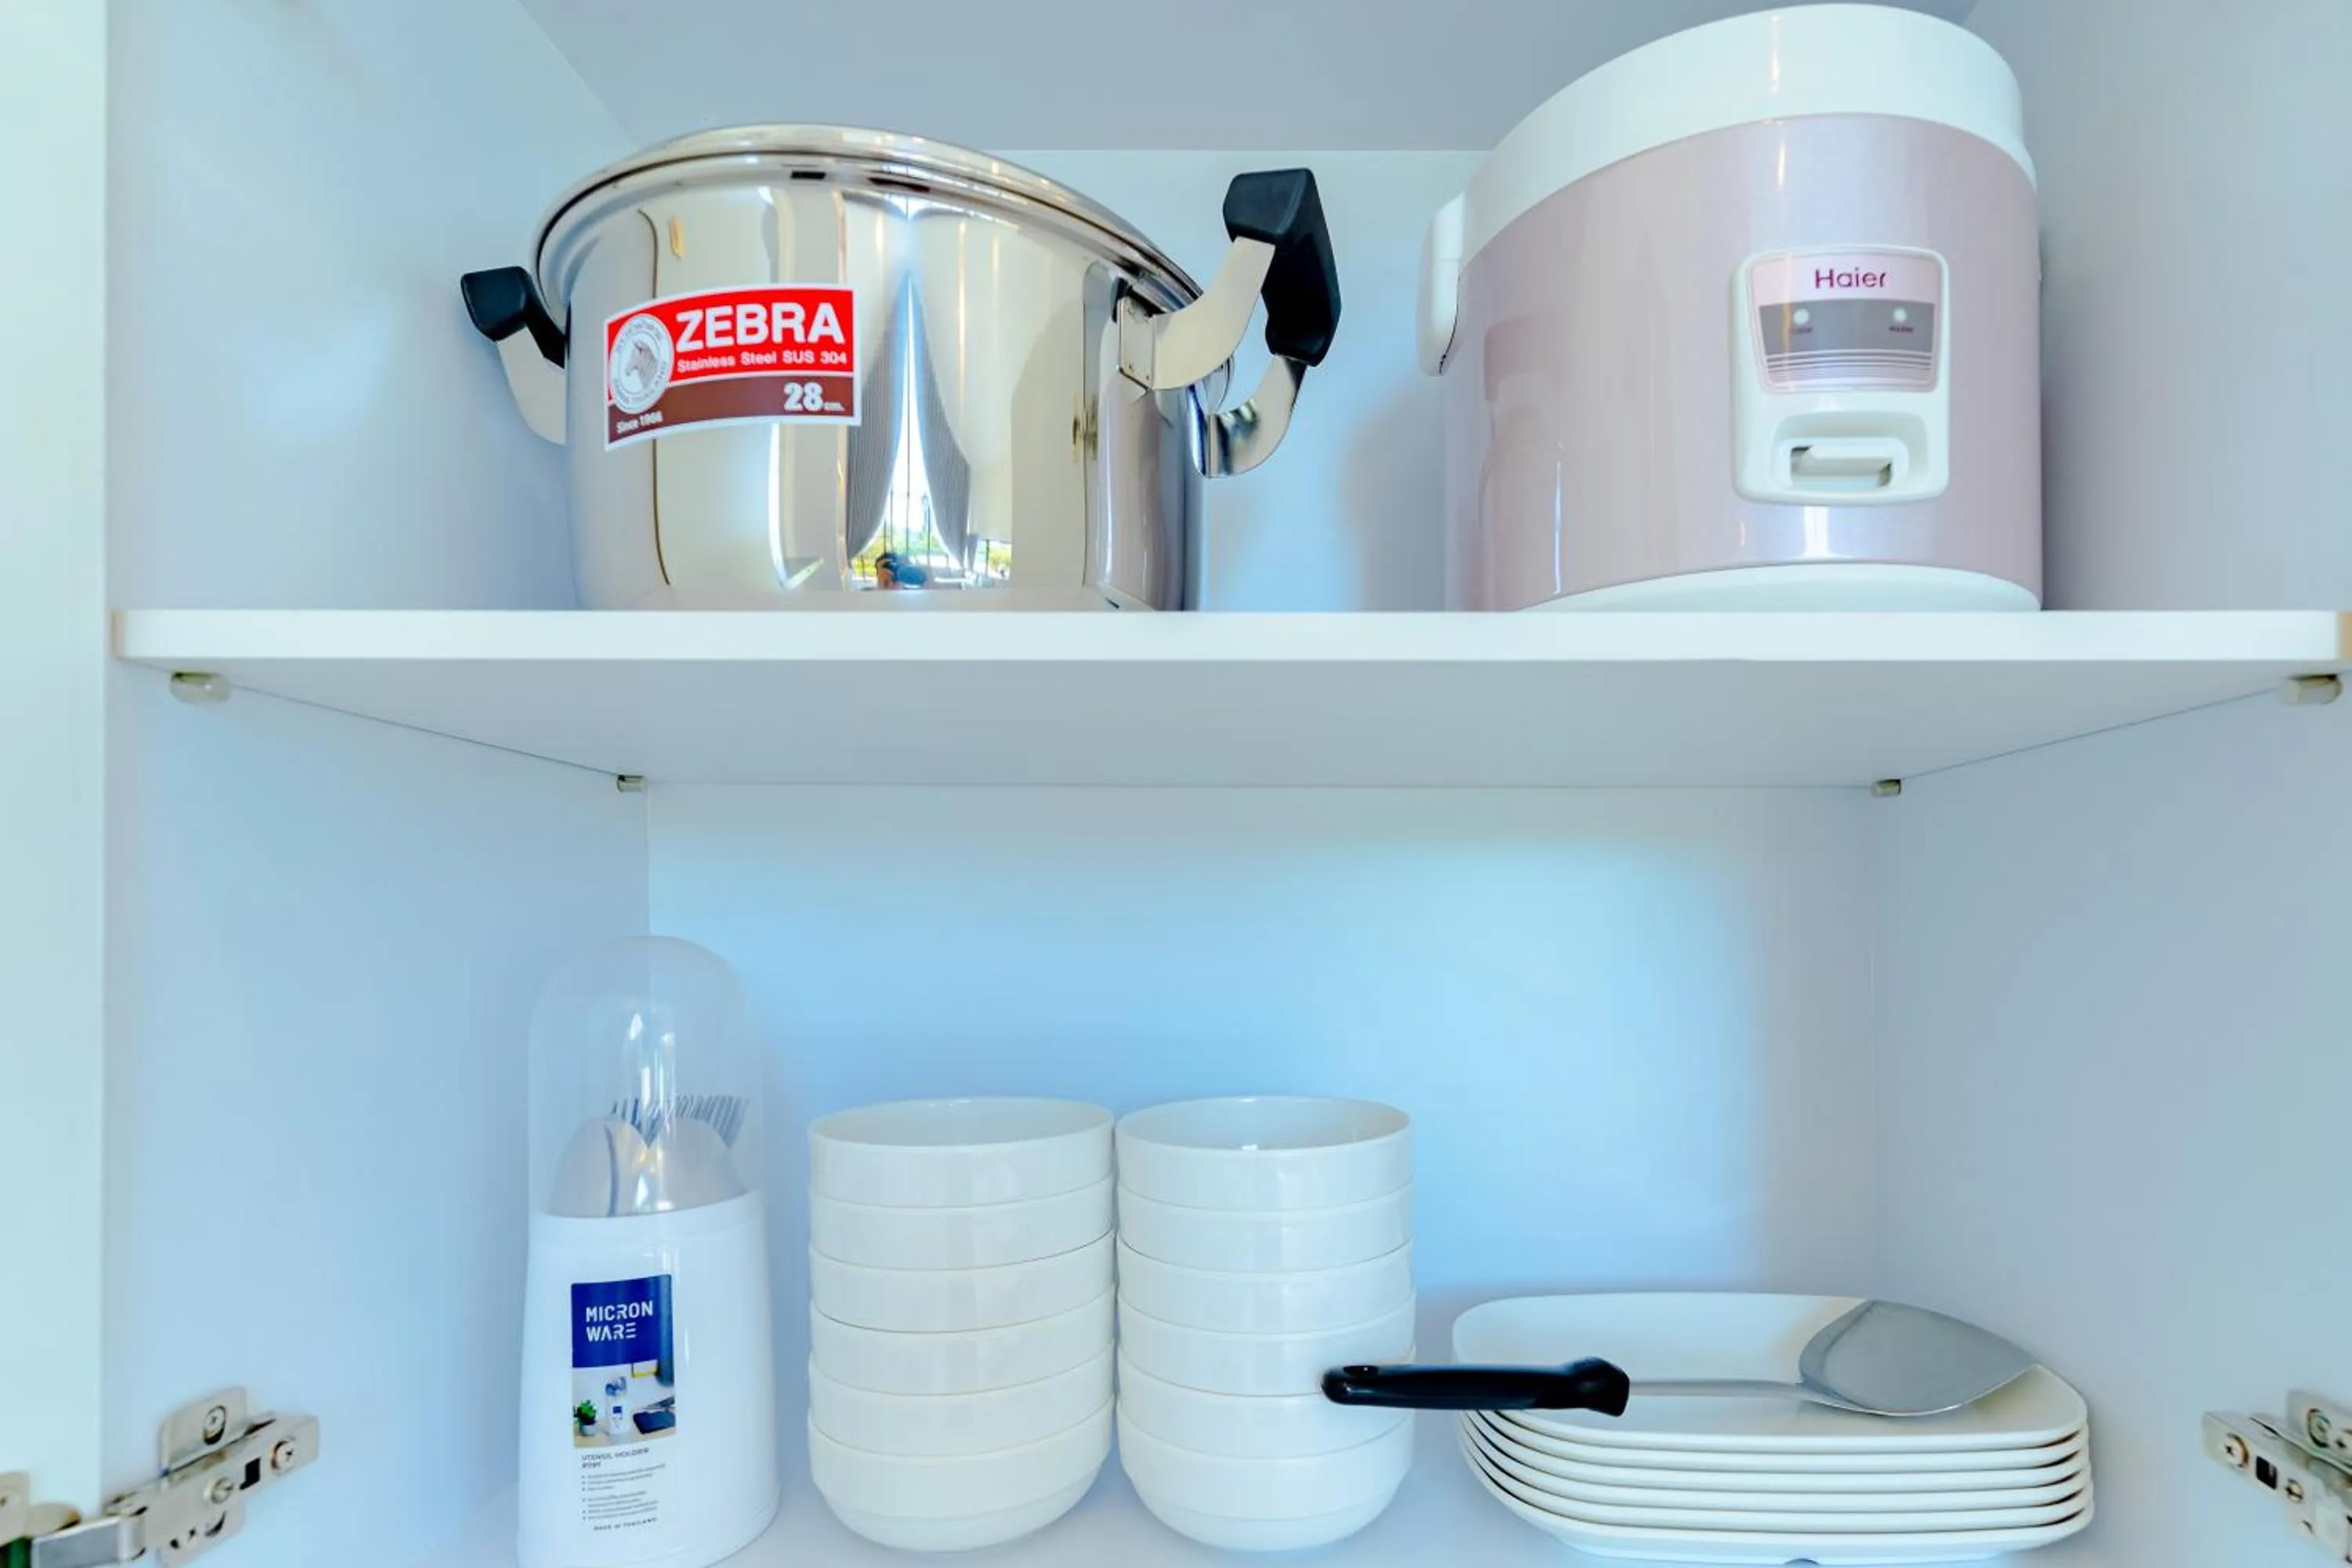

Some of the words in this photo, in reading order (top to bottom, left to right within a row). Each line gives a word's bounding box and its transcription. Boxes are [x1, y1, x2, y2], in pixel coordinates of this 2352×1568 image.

[1815, 267, 1886, 289] Haier
[676, 303, 846, 353] ZEBRA
[677, 355, 735, 373] Stainless
[741, 351, 777, 366] Steel
[782, 350, 814, 365] SUS
[820, 351, 847, 365] 304
[586, 1300, 653, 1323] MICRON
[586, 1322, 637, 1342] WARE
